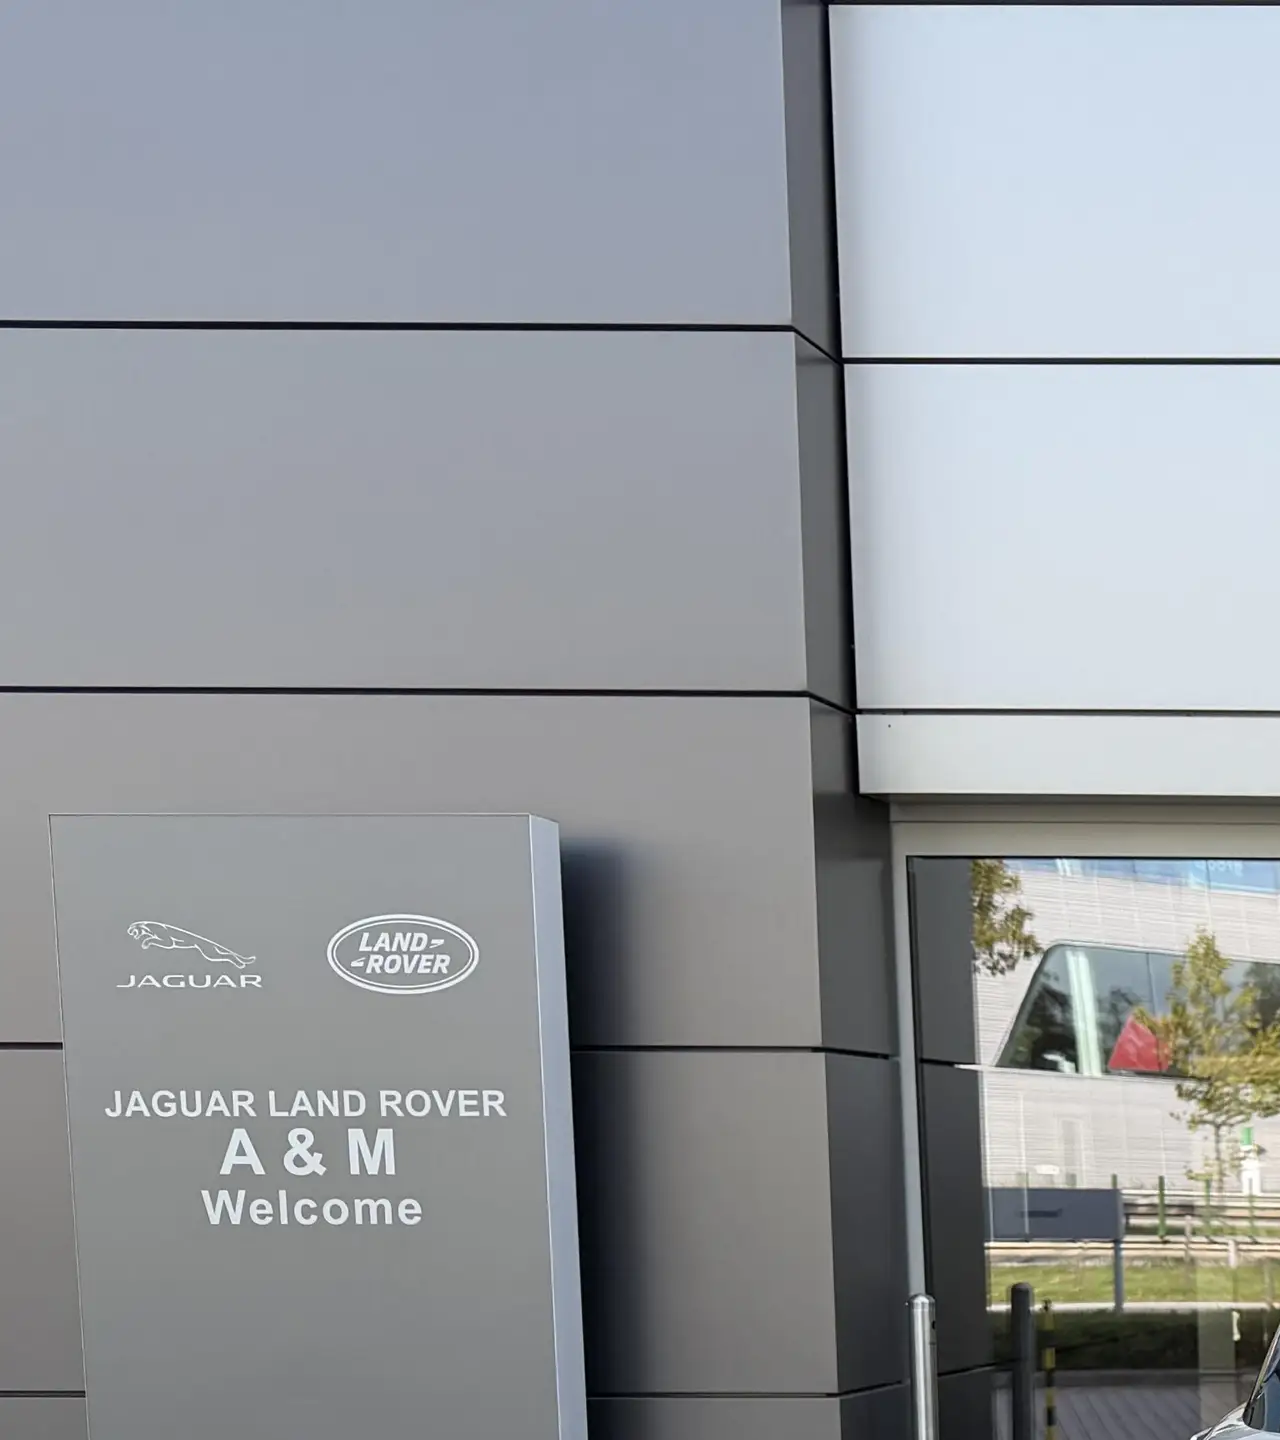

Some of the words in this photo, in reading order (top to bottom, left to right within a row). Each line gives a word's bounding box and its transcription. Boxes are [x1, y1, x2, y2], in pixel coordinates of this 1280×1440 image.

[116, 973, 263, 990] JAGUAR
[104, 1090, 258, 1119] JAGUAR
[268, 1090, 367, 1118] LAND
[379, 1090, 508, 1119] ROVER
[219, 1127, 266, 1176] A
[282, 1127, 327, 1177] &
[349, 1128, 397, 1176] M
[201, 1189, 424, 1226] Welcome
